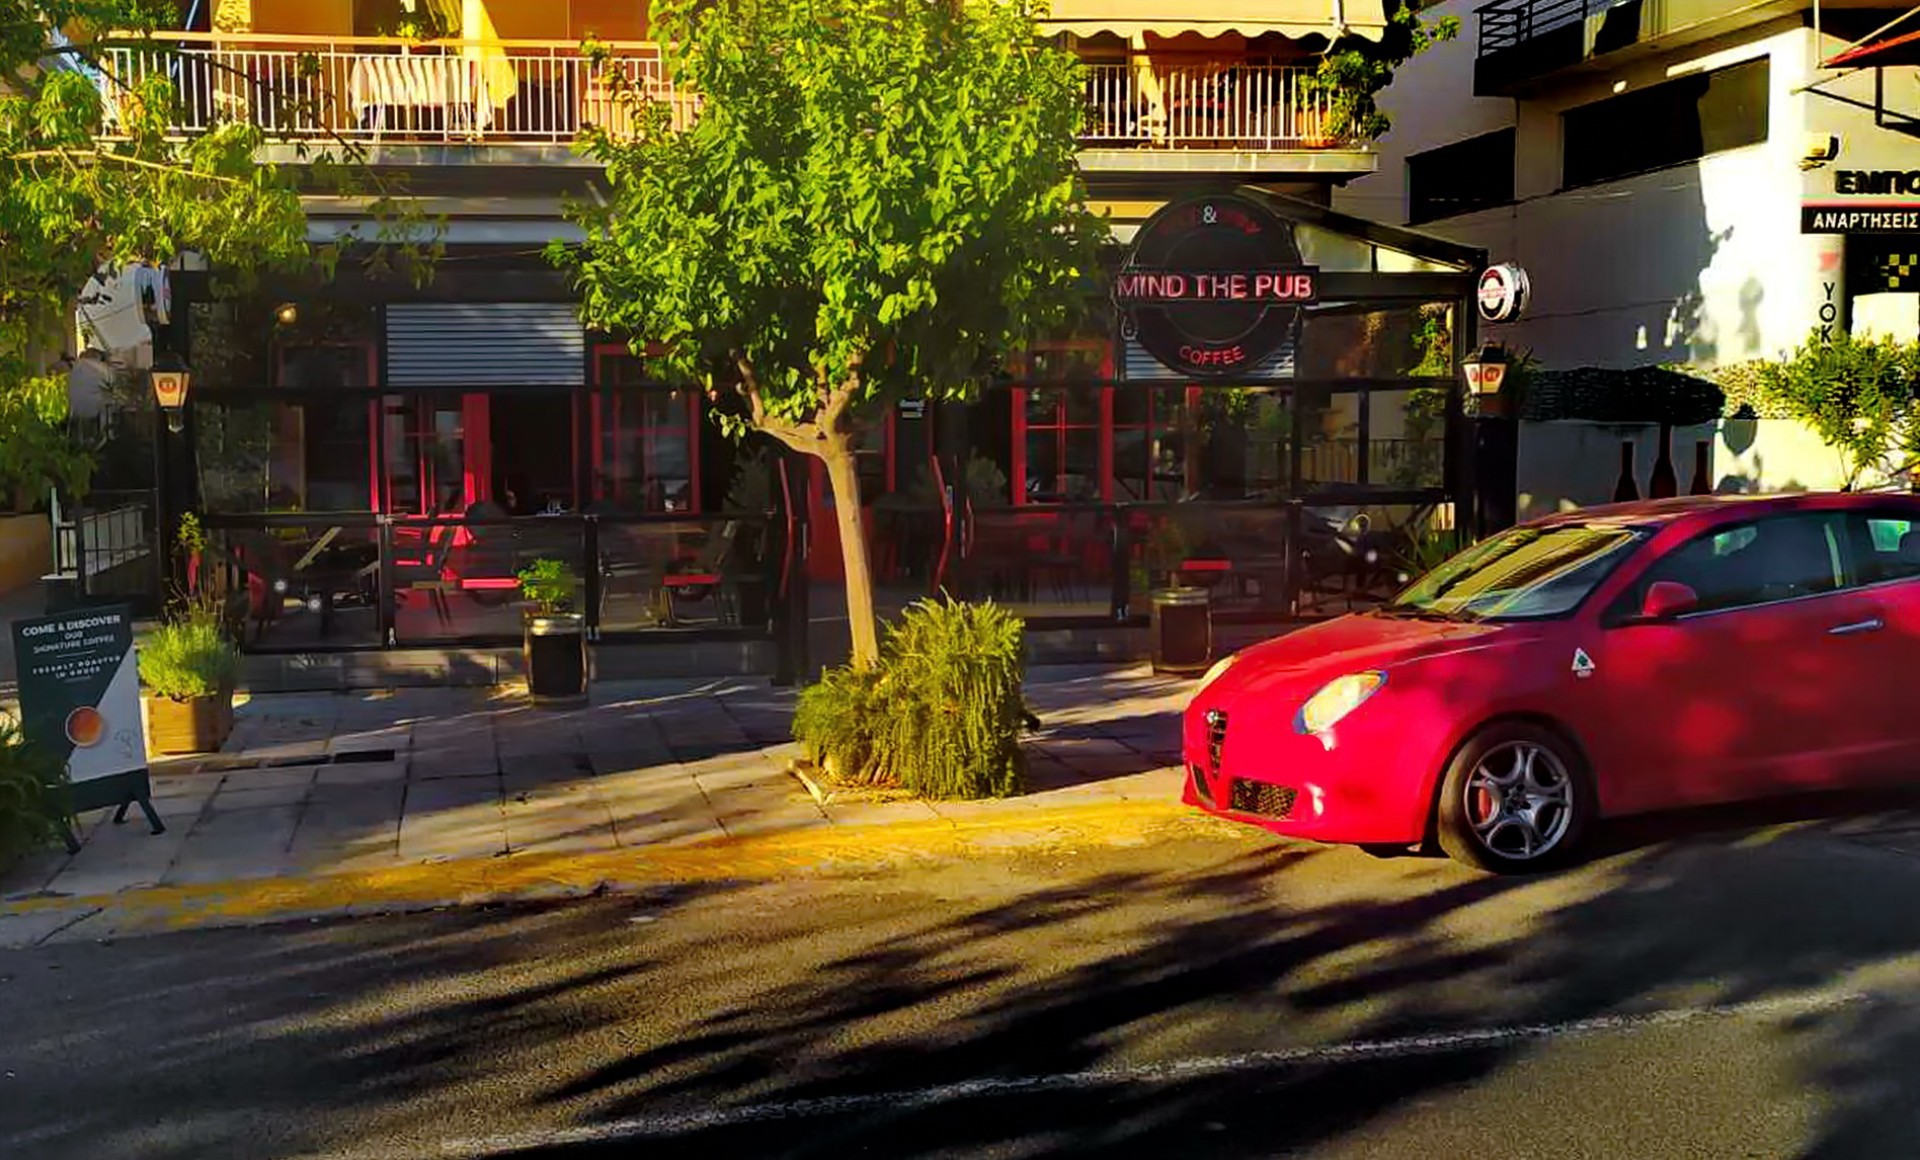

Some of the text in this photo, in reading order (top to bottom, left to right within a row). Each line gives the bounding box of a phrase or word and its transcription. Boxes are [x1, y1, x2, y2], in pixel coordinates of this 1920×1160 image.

[1202, 205, 1218, 224] &
[1812, 212, 1919, 229] ΑΝΑΡΤΗΣΕΙΣ
[1116, 274, 1313, 299] MIND THE PUB
[1179, 345, 1245, 365] COFFEE
[22, 624, 55, 636] COME
[66, 615, 120, 630] DISCOVER
